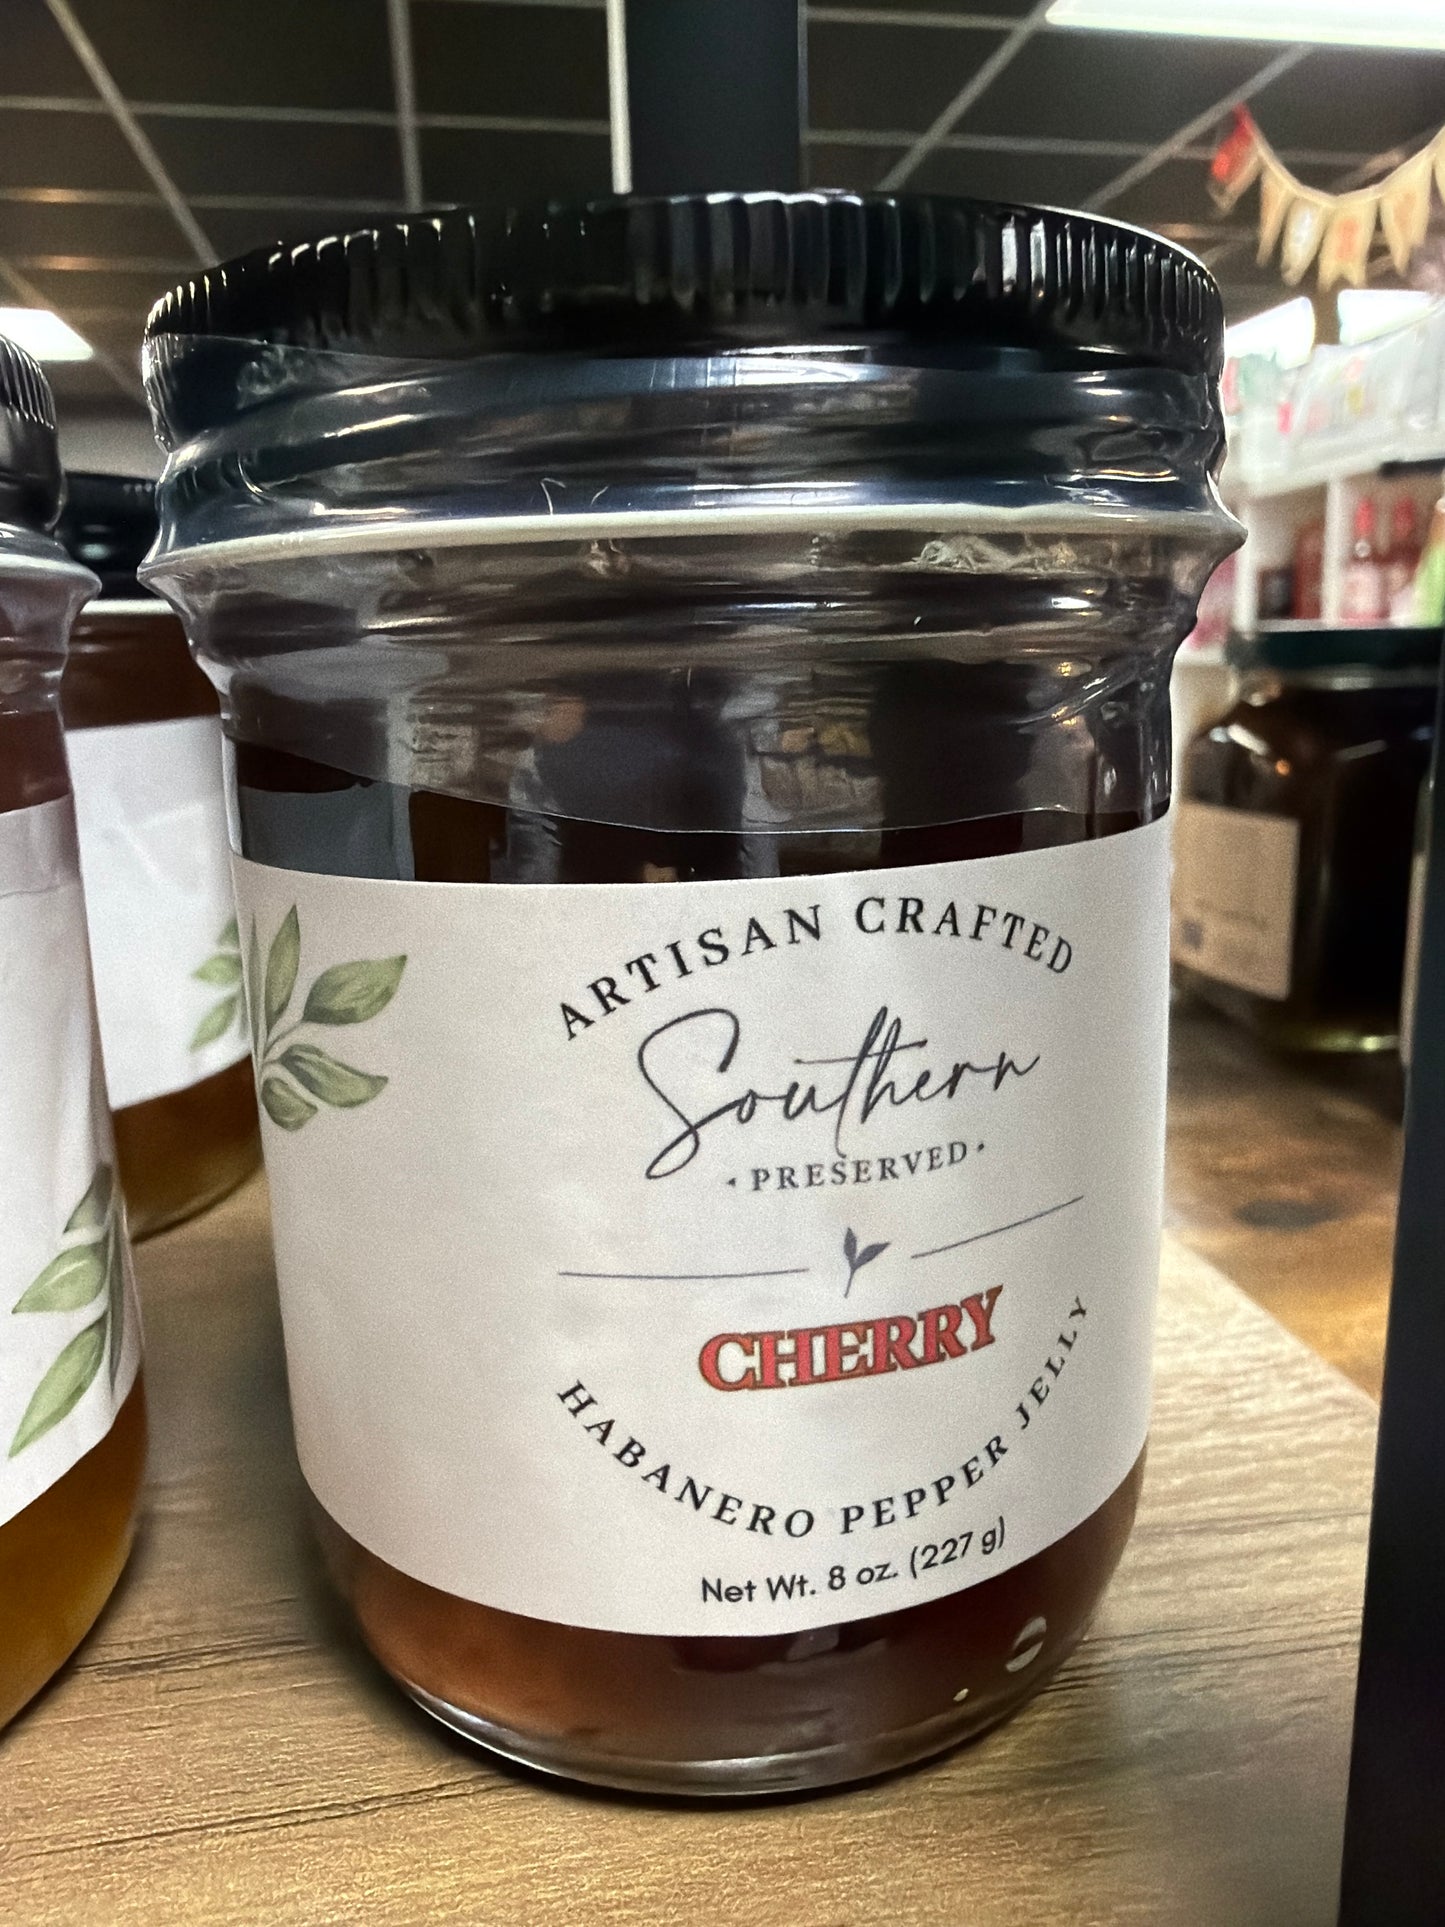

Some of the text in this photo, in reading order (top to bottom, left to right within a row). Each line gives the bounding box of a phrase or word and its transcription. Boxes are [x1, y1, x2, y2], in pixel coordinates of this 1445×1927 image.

[560, 896, 1074, 1040] ARTISAN CRAFTED
[638, 1006, 1040, 1181] Southern
[698, 1284, 1005, 1392] CHERRY
[557, 1296, 1089, 1539] HABANERO PEPPER JELLY
[701, 1515, 1008, 1604] Net Wt. 8 oz. (227 g)
